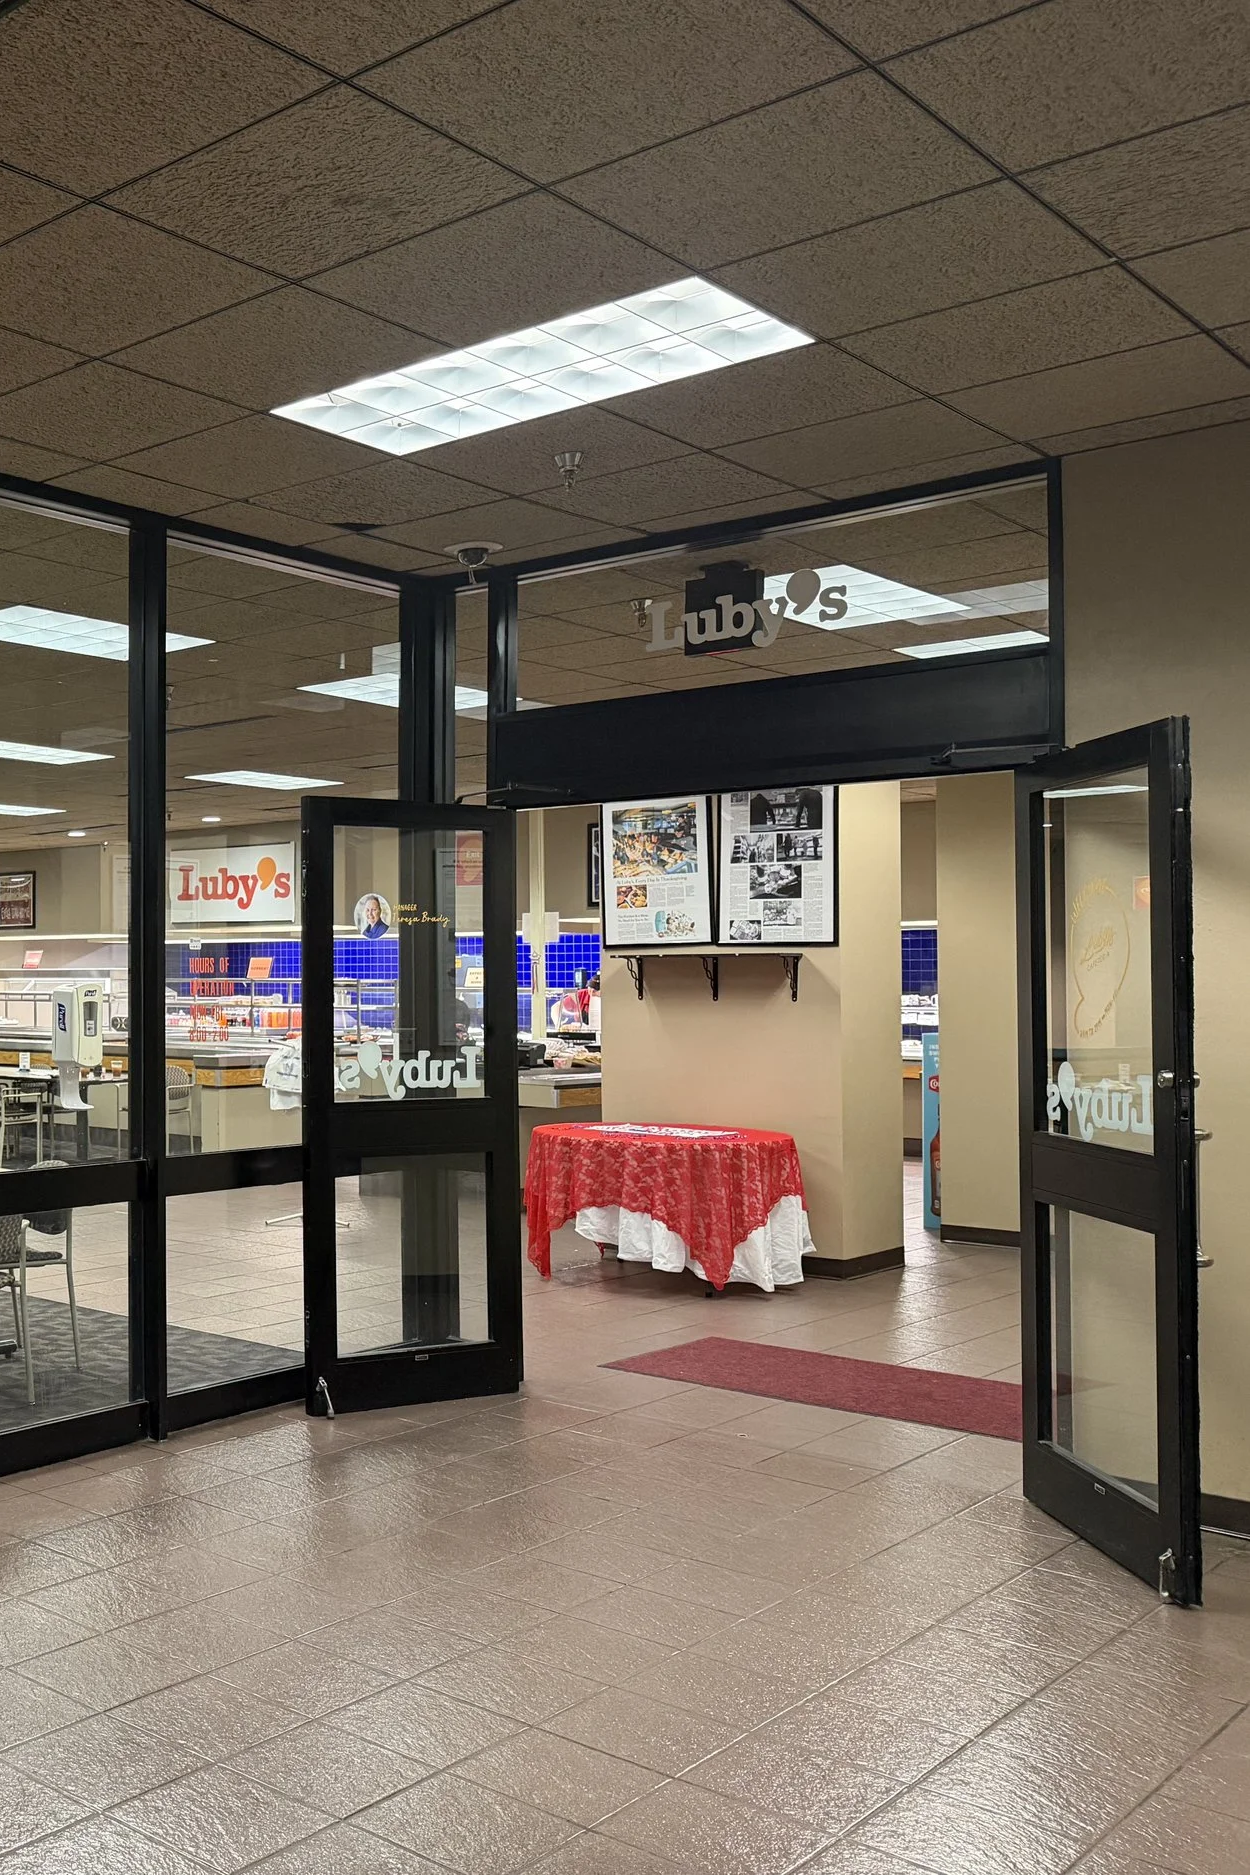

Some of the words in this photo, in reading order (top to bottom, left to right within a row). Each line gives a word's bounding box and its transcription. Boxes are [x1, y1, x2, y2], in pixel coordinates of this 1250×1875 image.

[645, 568, 849, 652] Luby's
[177, 857, 291, 910] Luby's
[421, 911, 451, 928] Brady
[189, 957, 215, 974] HOURS
[219, 957, 230, 973] OF
[189, 979, 235, 997] OPERATION
